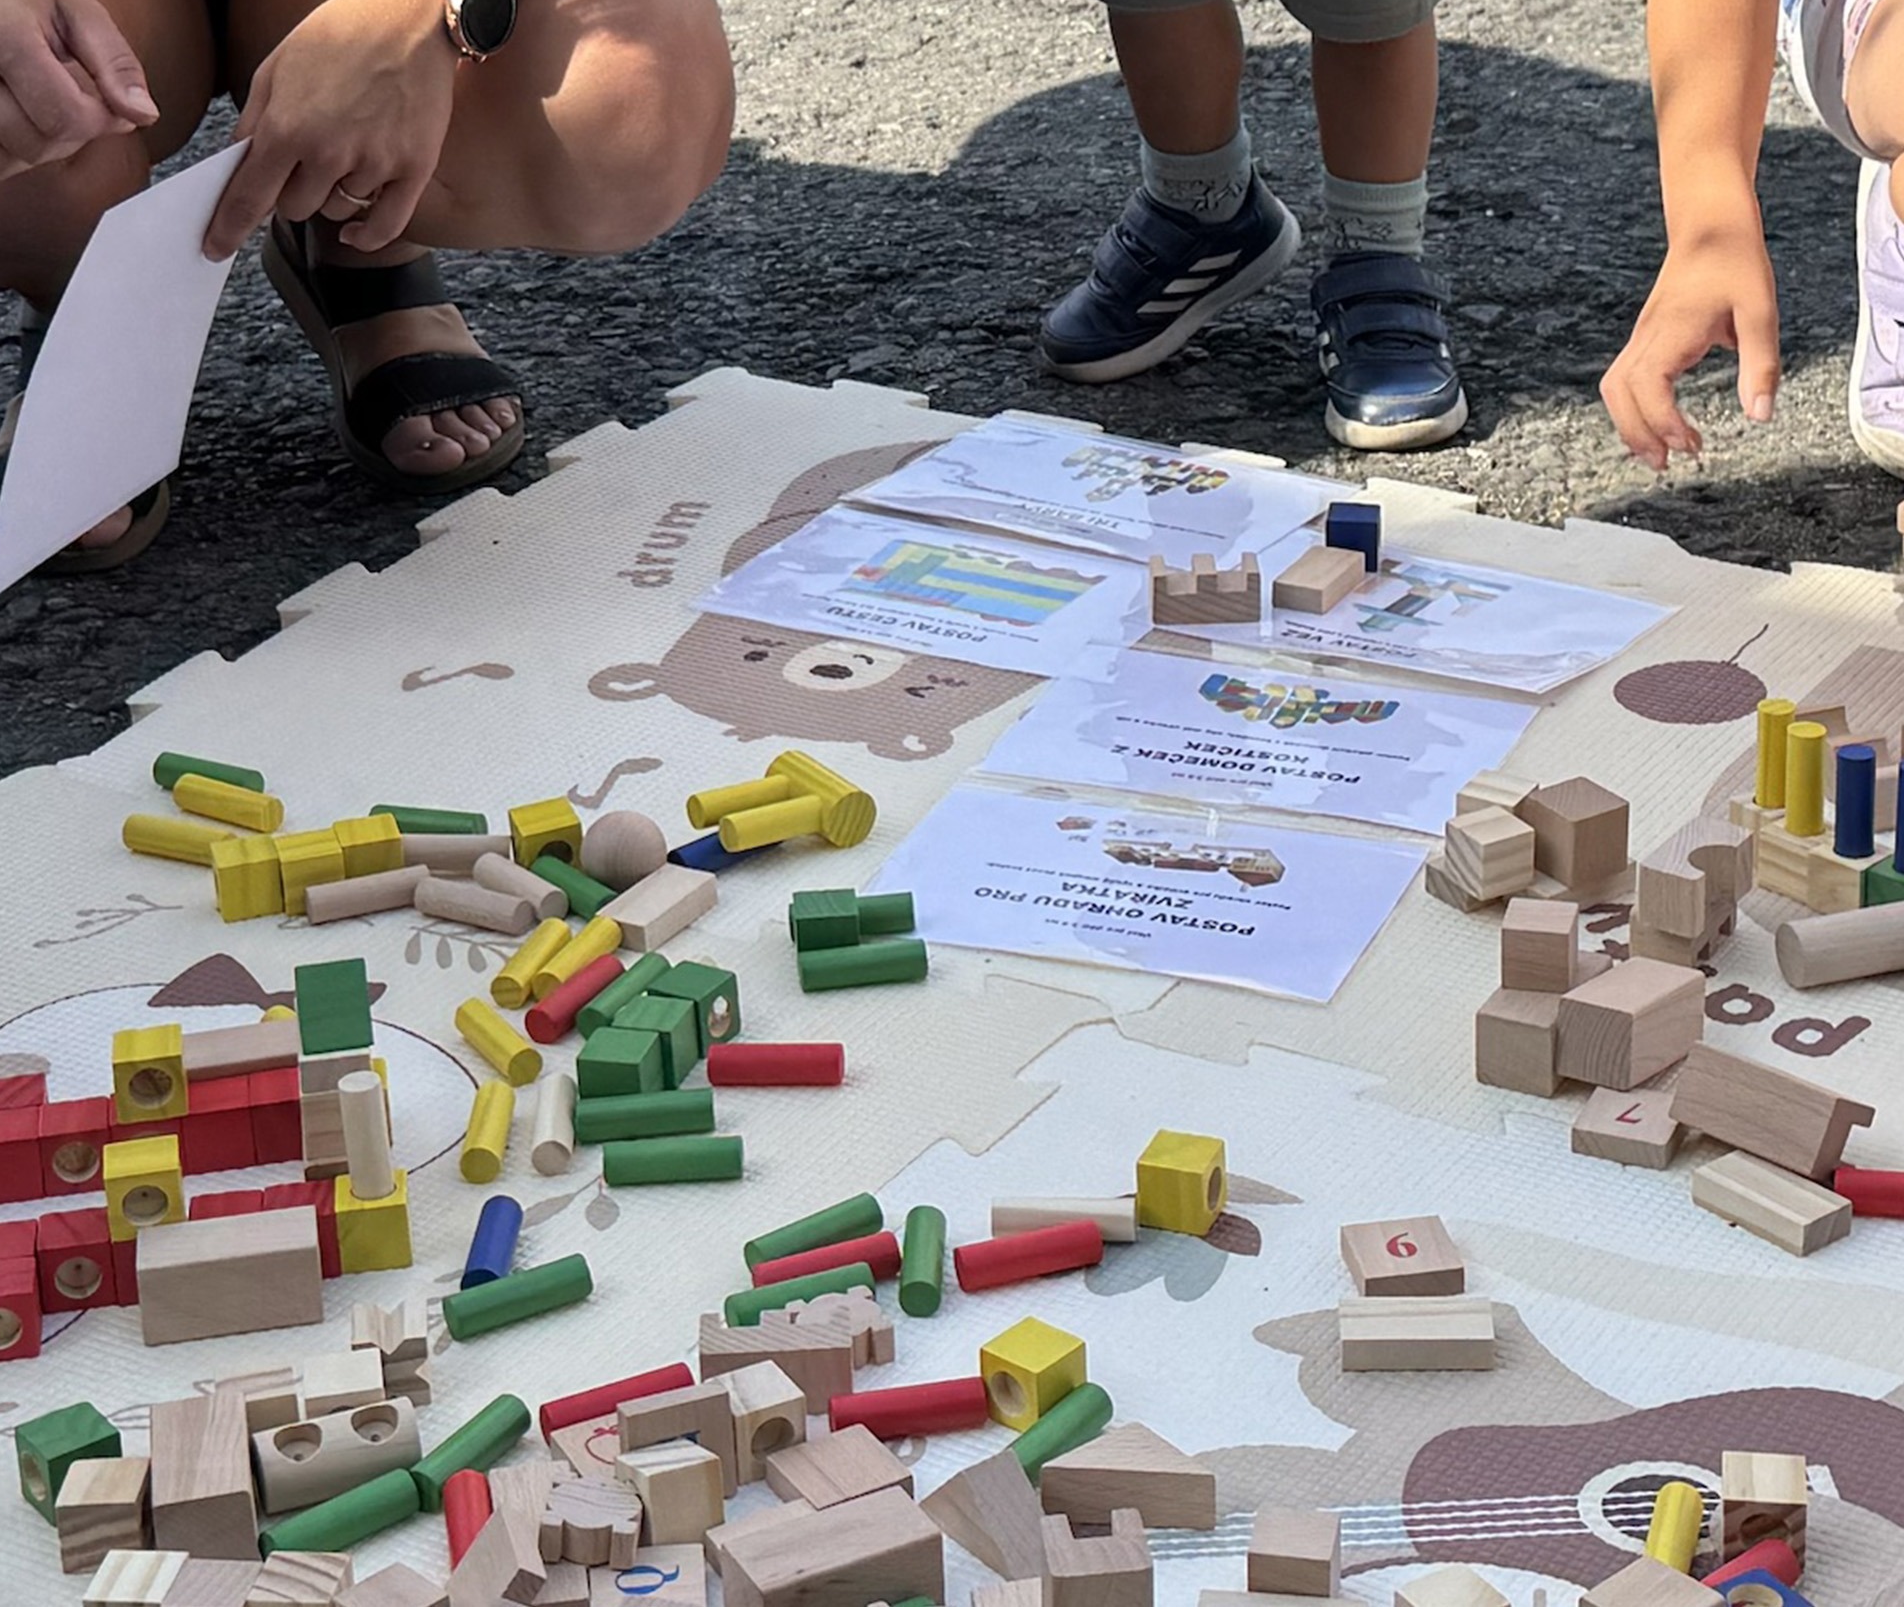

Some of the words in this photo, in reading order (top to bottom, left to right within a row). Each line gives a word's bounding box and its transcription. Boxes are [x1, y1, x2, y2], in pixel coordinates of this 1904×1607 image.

[617, 500, 712, 587] drum
[826, 605, 897, 626] CESTU
[902, 621, 988, 643] POSTAV
[1134, 748, 1256, 772] DOMEČEK
[1184, 740, 1309, 764] KOSTIČEK
[1262, 764, 1361, 784] POSTAV
[974, 886, 1028, 902] PRO
[1062, 881, 1193, 910] ZVÍŘÁTKA
[1033, 895, 1144, 919] OHRADU
[1150, 912, 1256, 936] POSTAV
